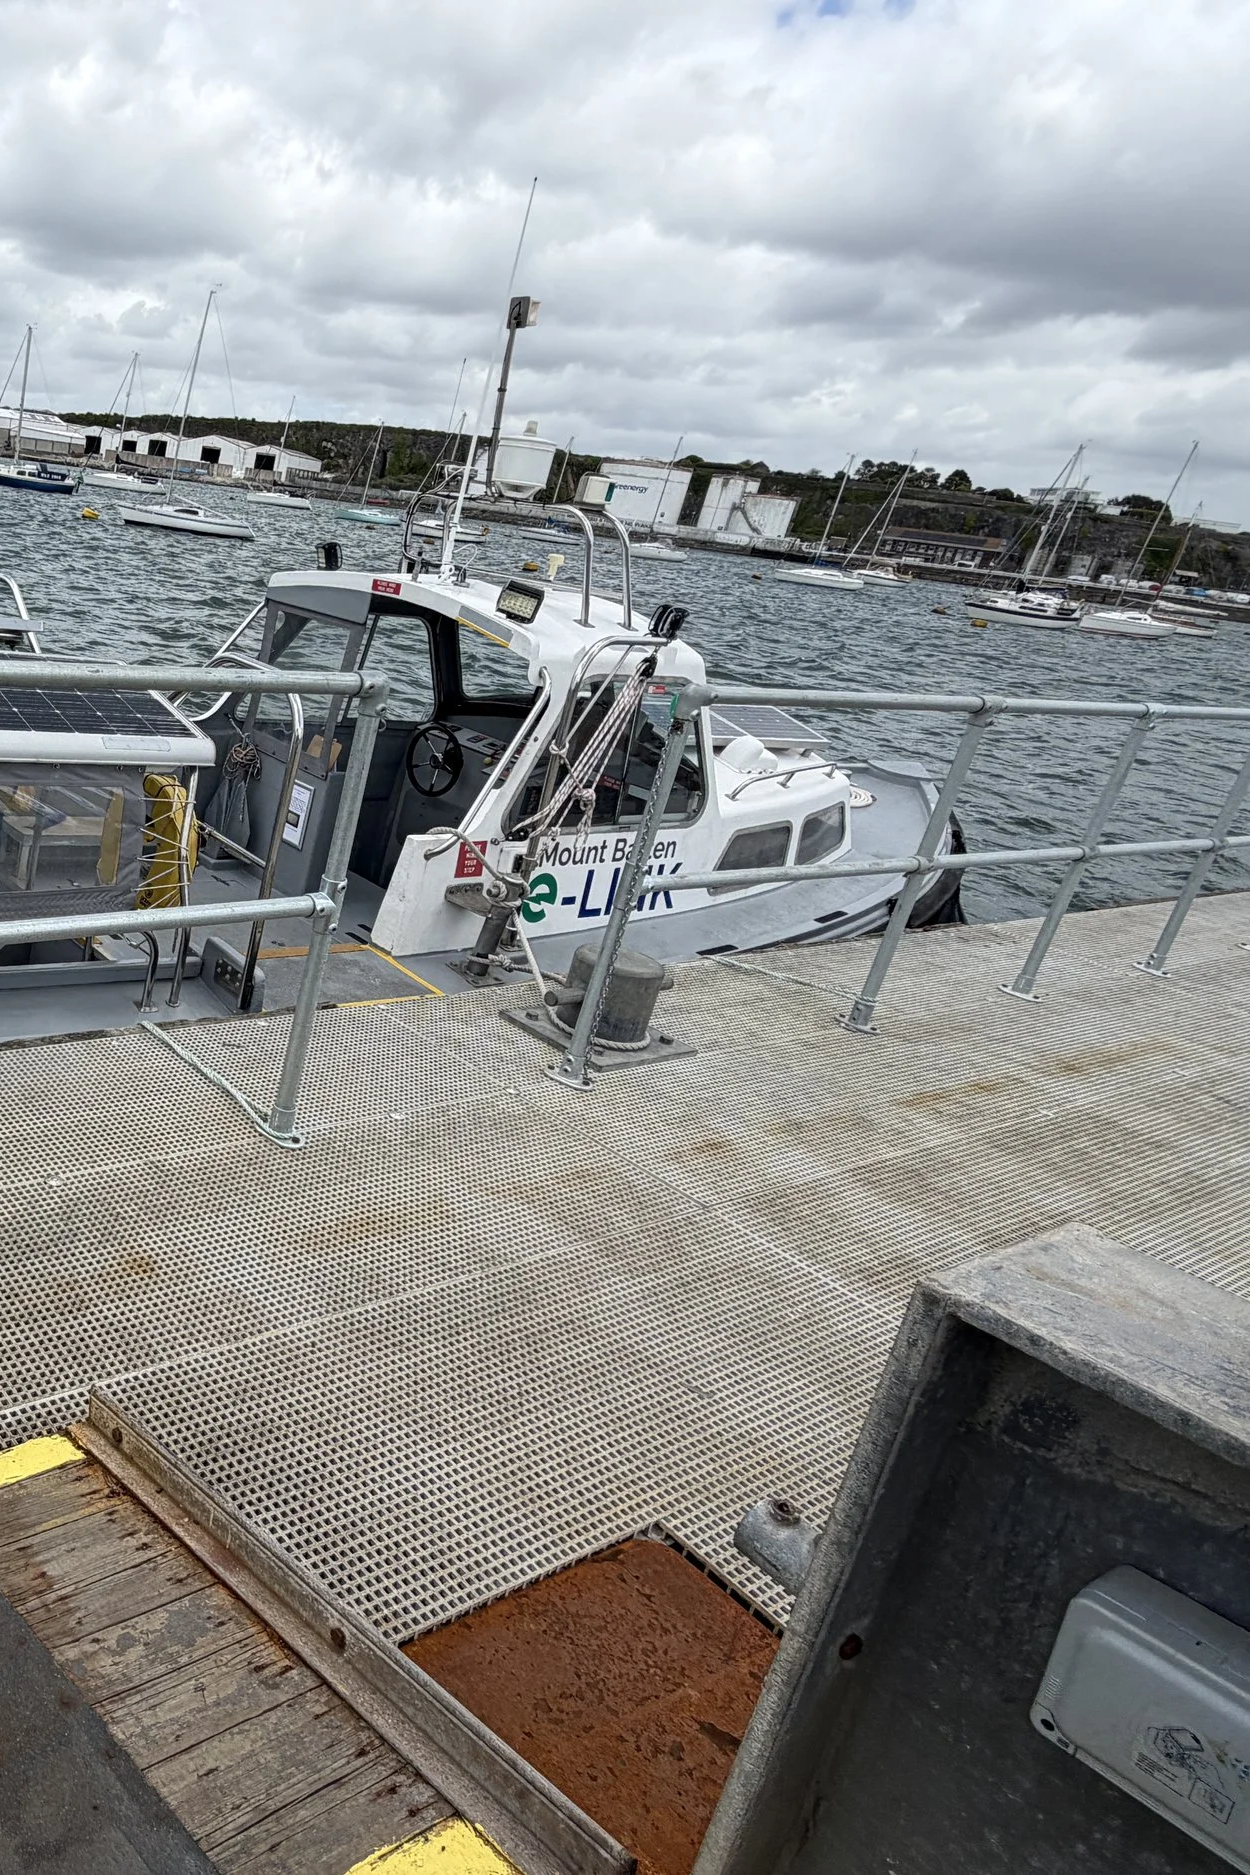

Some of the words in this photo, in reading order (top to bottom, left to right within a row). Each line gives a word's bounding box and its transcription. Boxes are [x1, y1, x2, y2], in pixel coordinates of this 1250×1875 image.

[614, 484, 649, 494] reenergy
[538, 840, 607, 867] Mount
[611, 838, 677, 863] Baen
